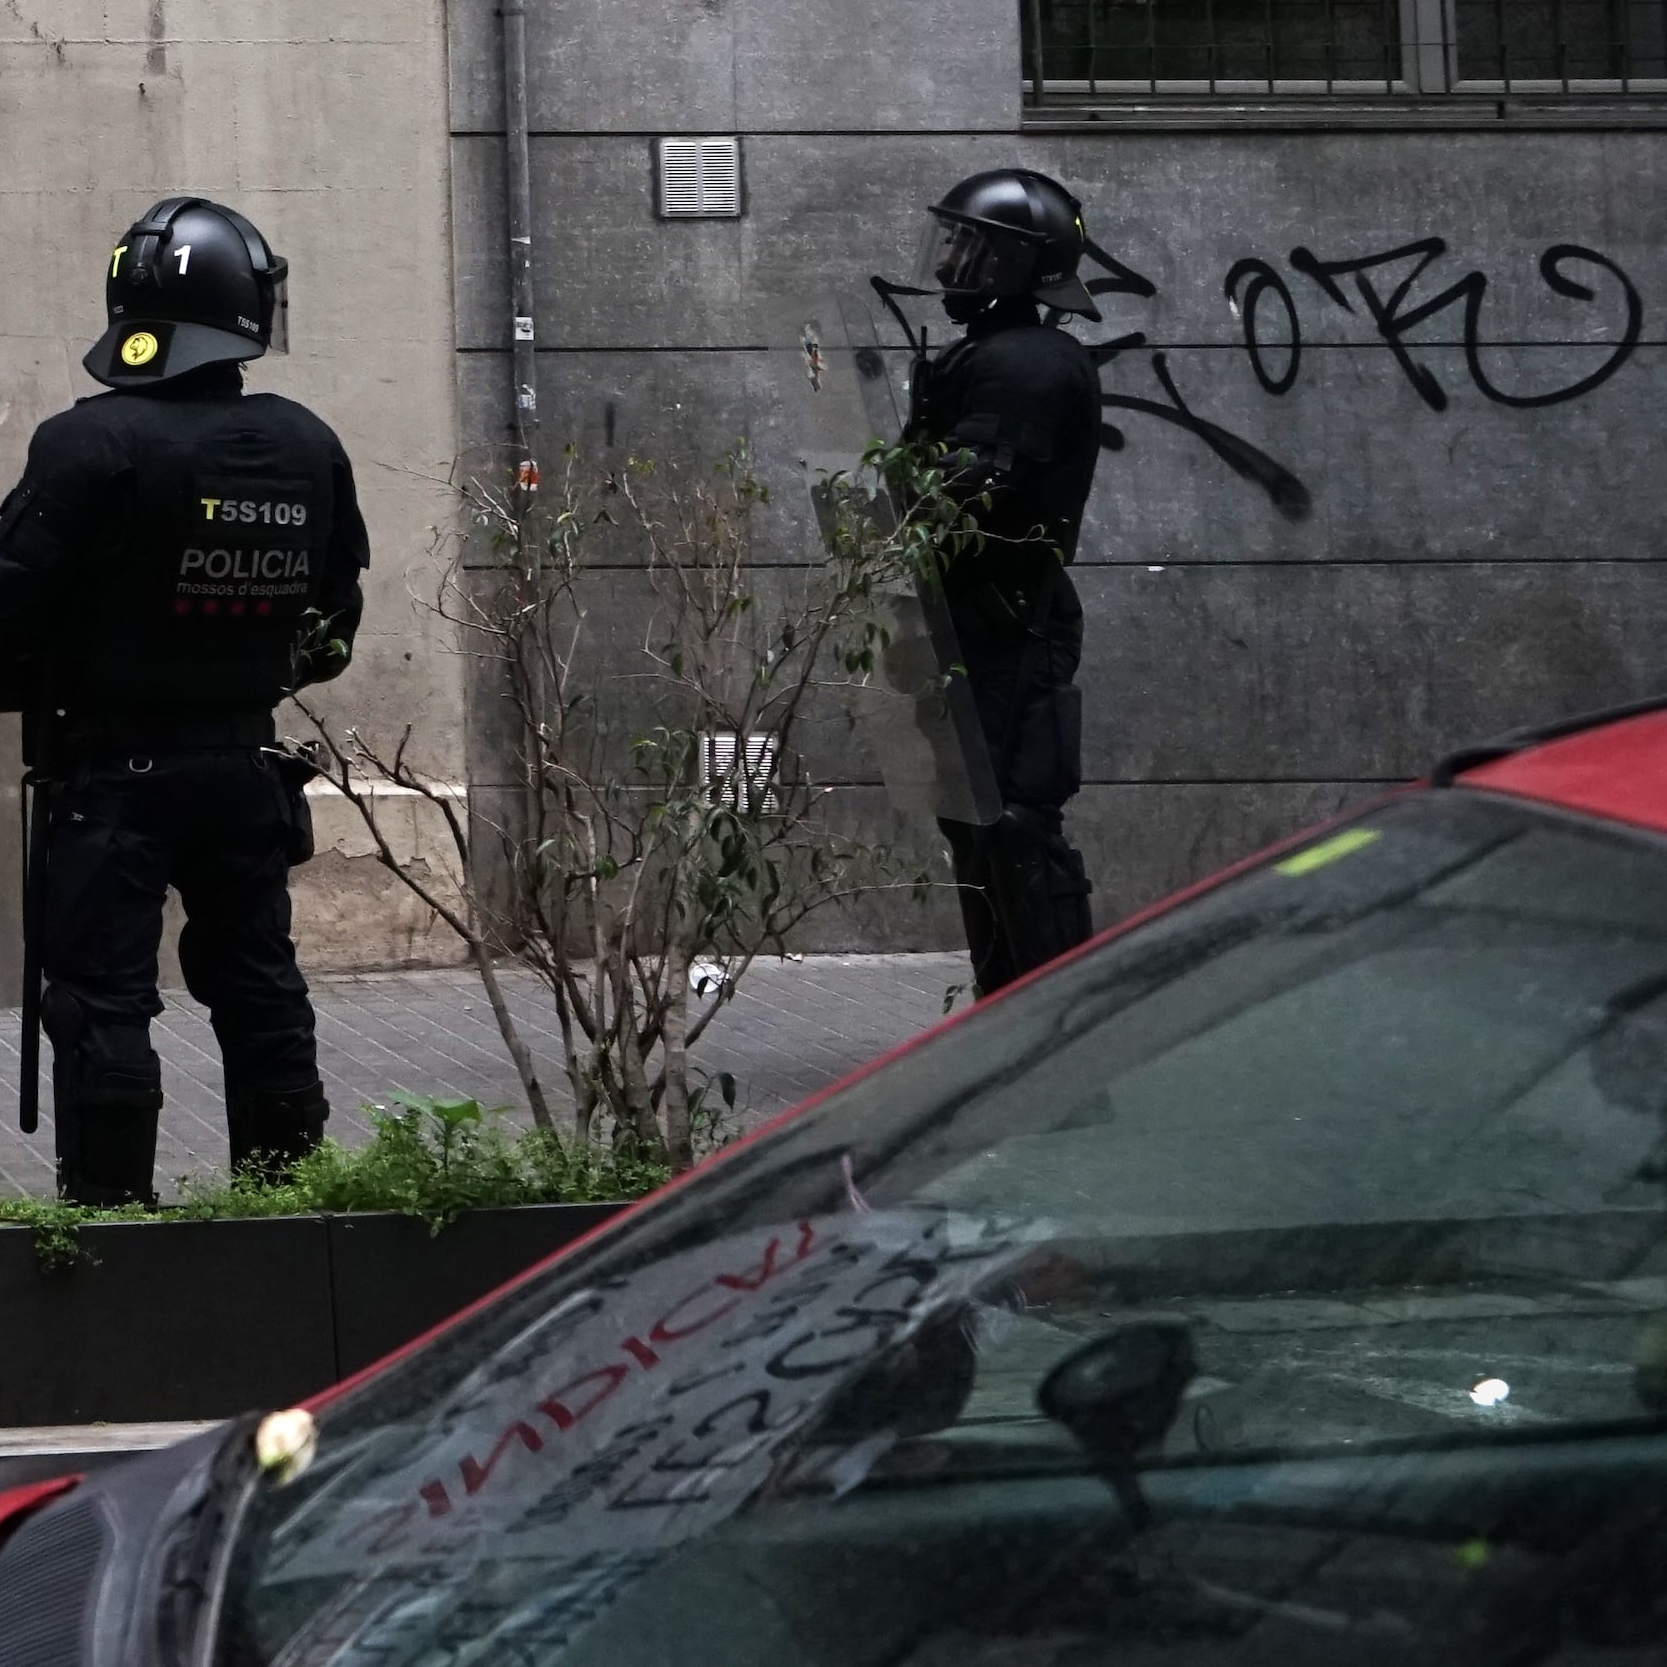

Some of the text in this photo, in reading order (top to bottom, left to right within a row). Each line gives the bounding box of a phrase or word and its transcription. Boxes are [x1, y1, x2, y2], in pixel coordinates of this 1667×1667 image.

[112, 244, 192, 278] T 1
[200, 497, 308, 526] T5S109
[179, 547, 310, 579] POLICIA
[176, 580, 309, 598] mossos d'esquadra
